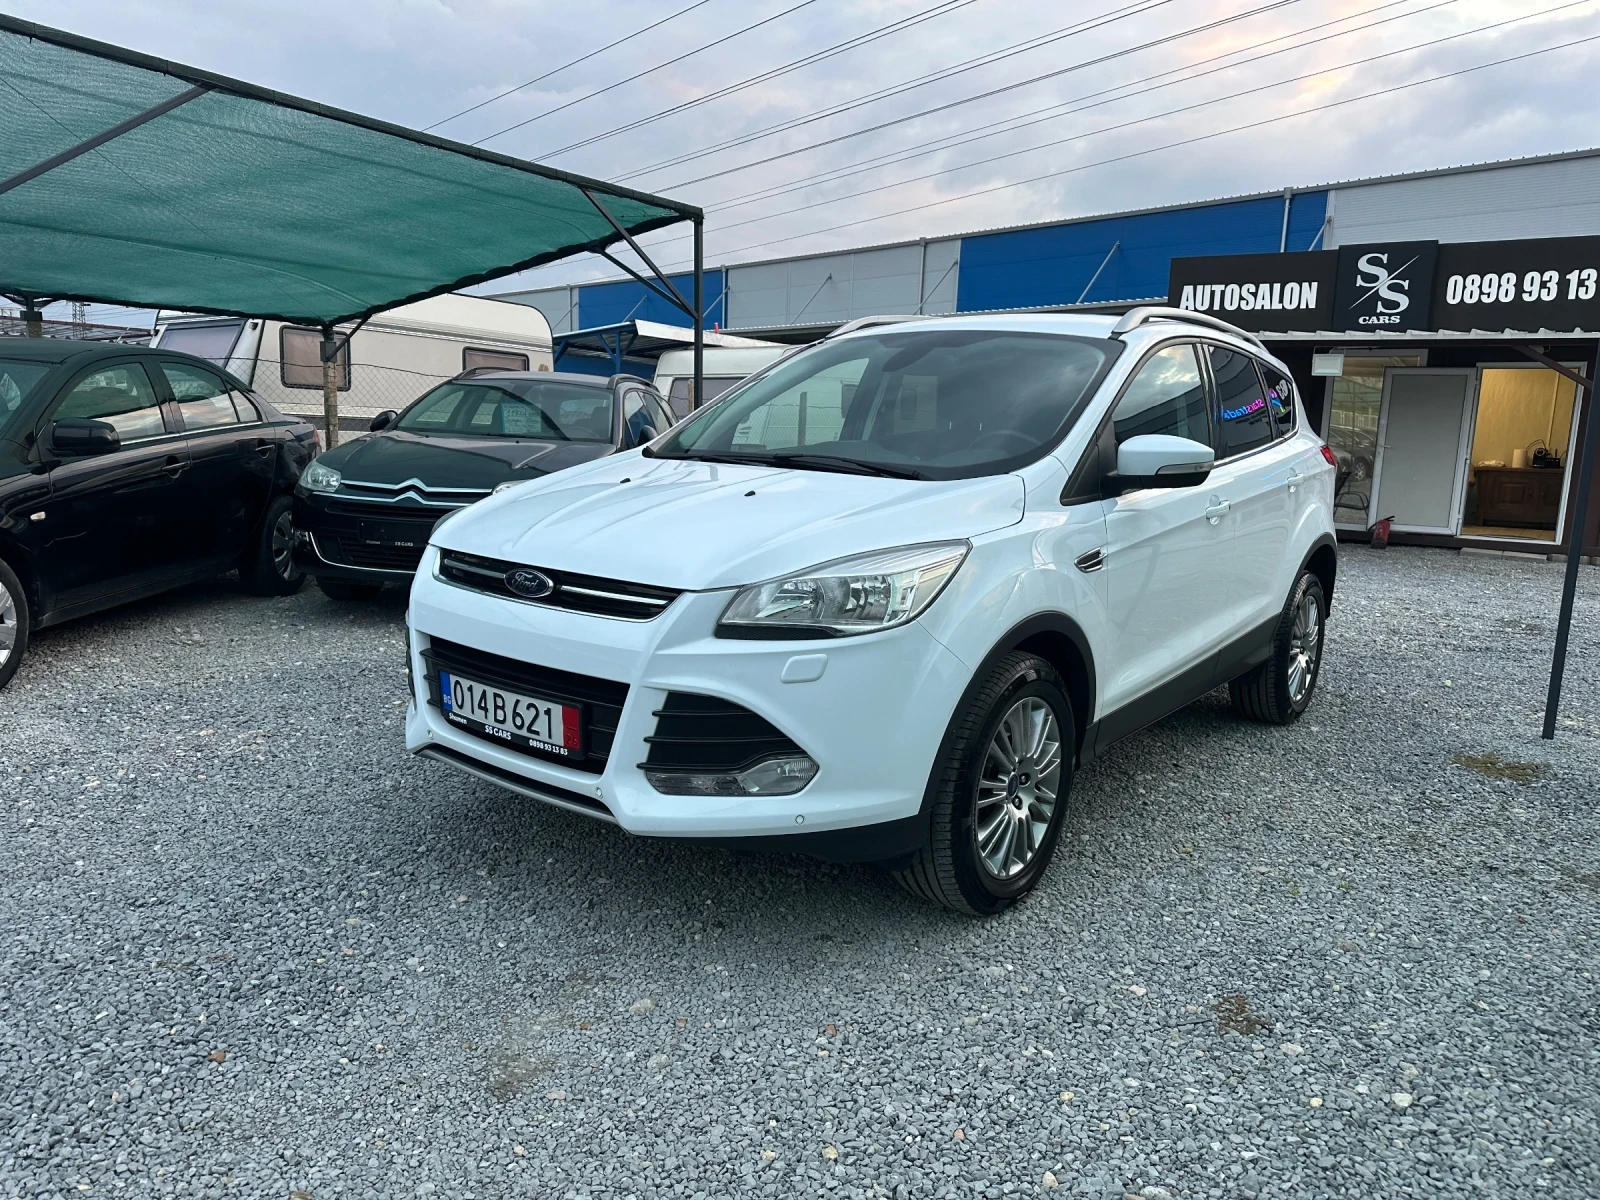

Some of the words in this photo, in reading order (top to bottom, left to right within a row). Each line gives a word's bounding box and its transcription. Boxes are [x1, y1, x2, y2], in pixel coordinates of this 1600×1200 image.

[1179, 282, 1318, 311] AUTOSALON
[1446, 272, 1517, 305] 0898
[1522, 270, 1560, 302] 93
[1565, 268, 1598, 300] 13
[1358, 315, 1401, 325] CARS
[511, 571, 540, 592] Ford
[453, 679, 553, 740] 014B621
[484, 725, 493, 735] SS
[493, 727, 512, 740] CARS
[528, 739, 544, 749] 0898
[552, 745, 560, 753] 13
[560, 748, 568, 756] 83
